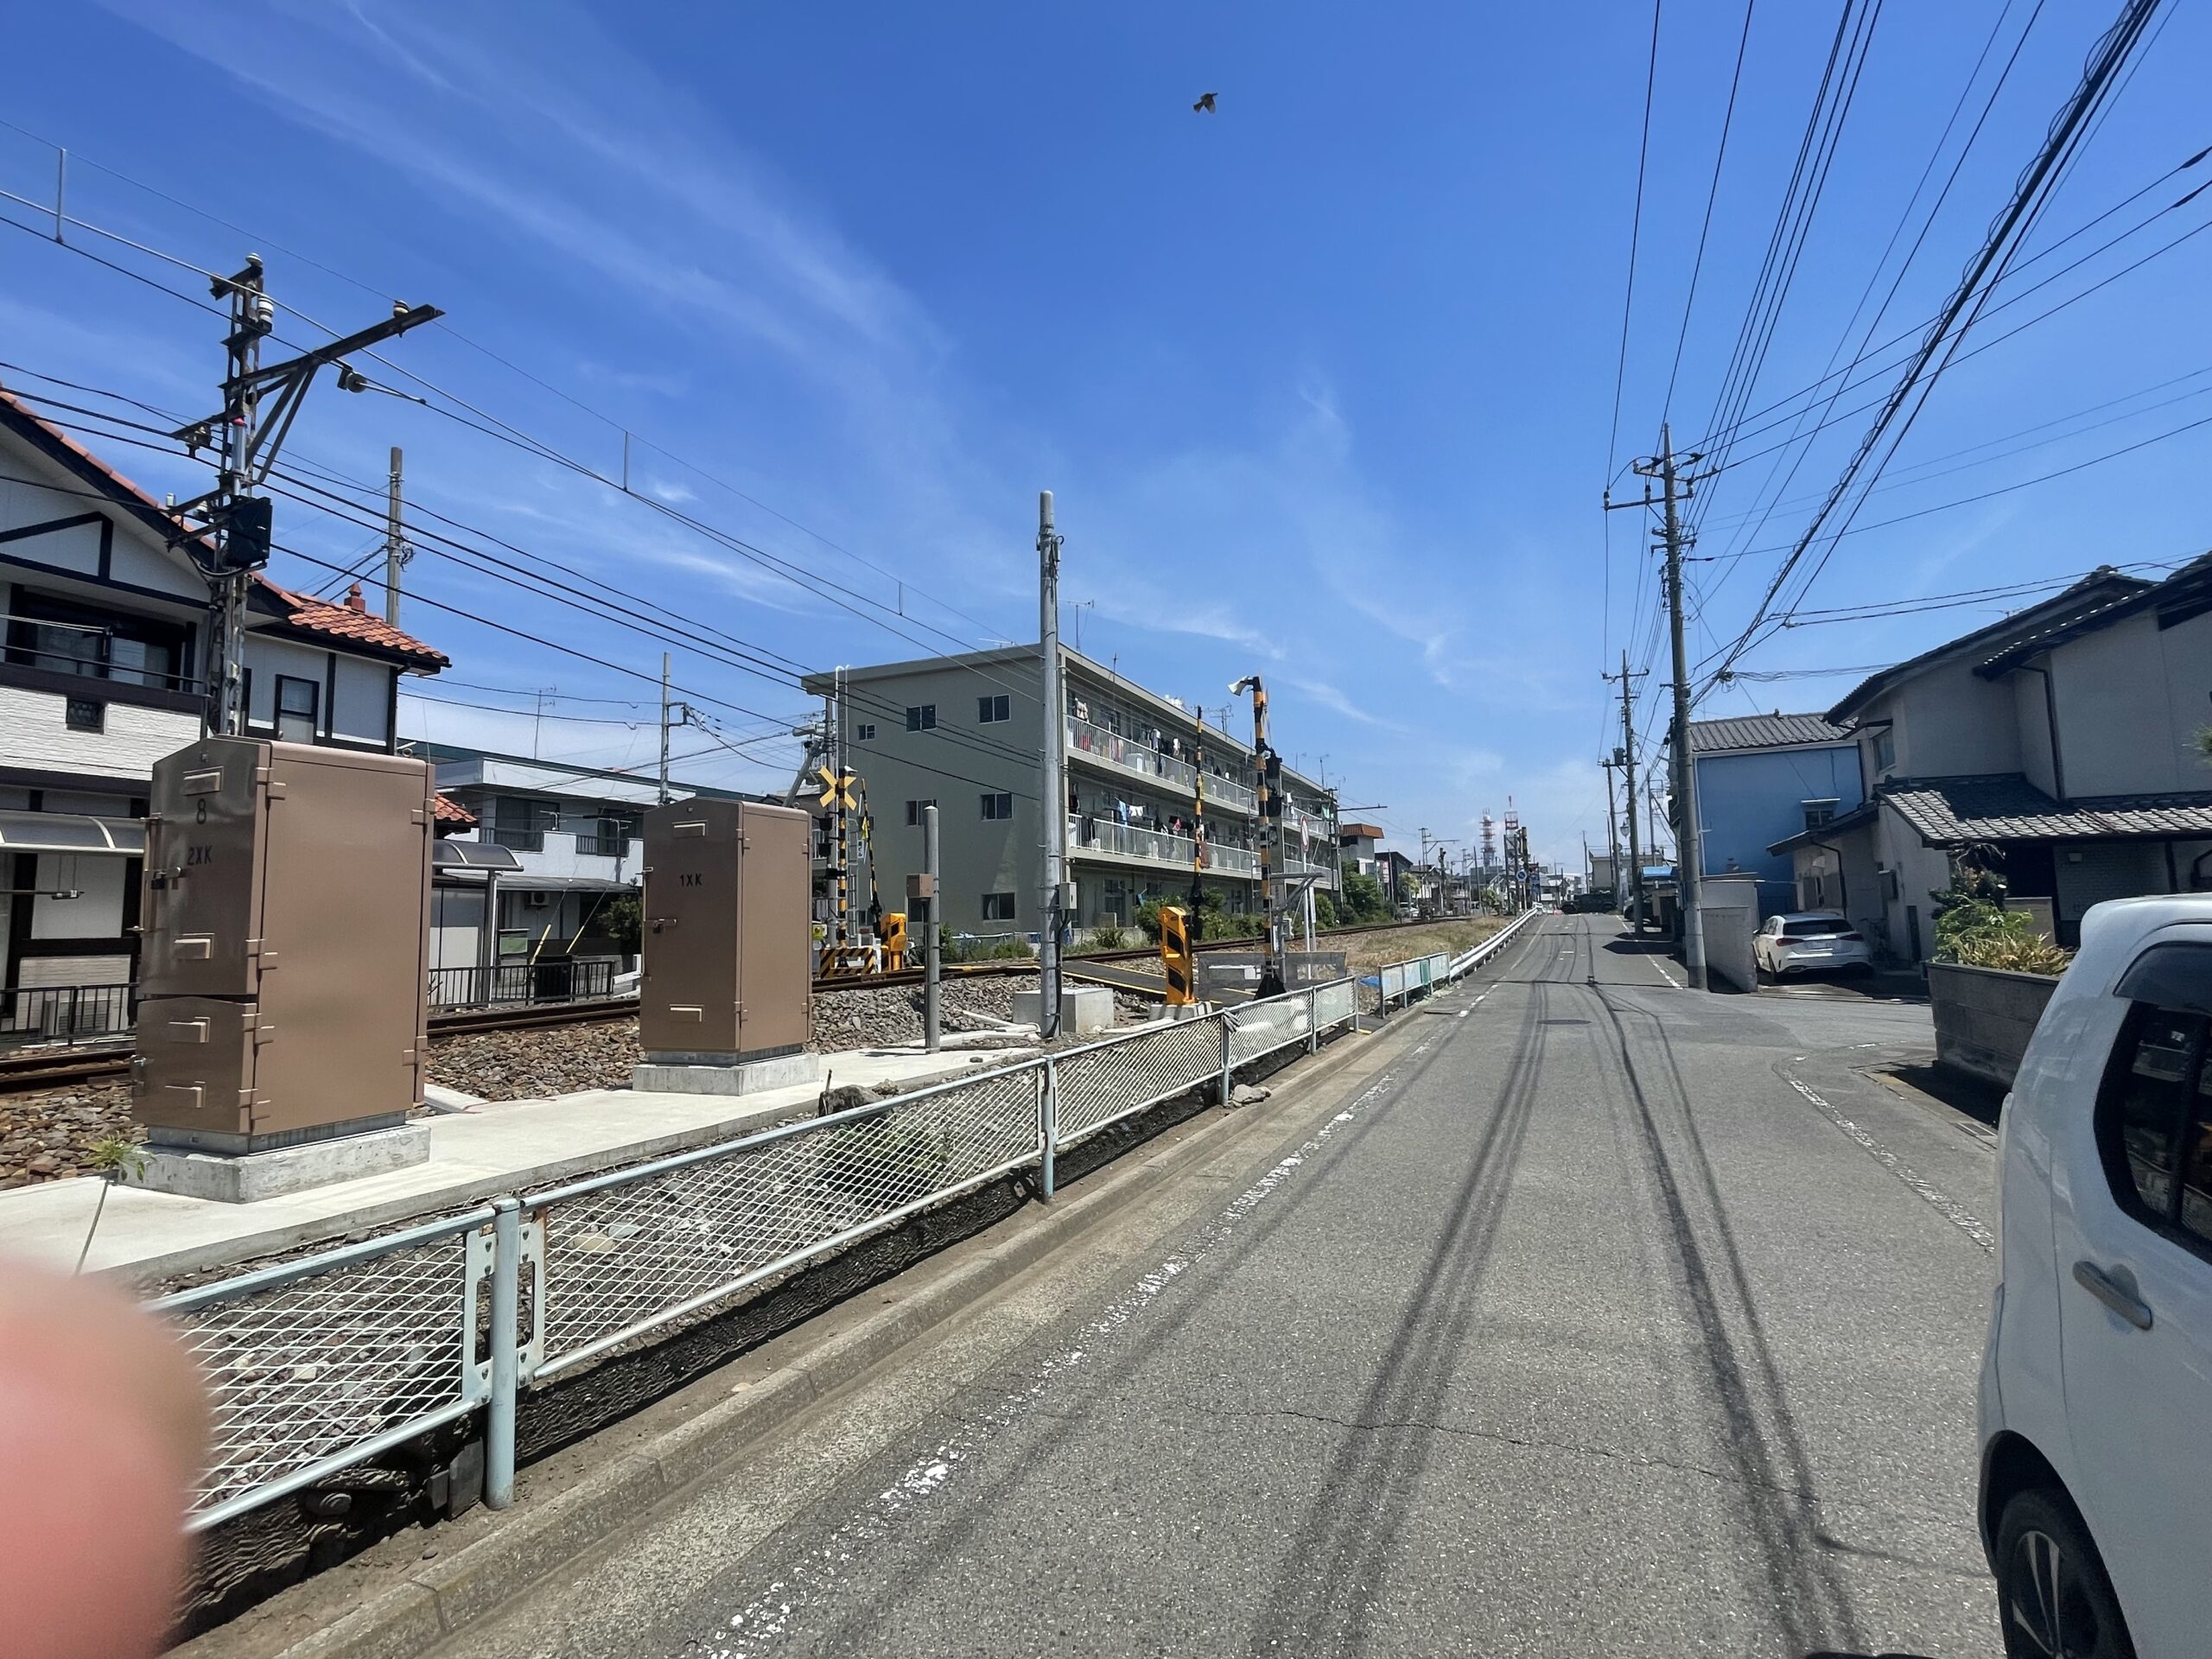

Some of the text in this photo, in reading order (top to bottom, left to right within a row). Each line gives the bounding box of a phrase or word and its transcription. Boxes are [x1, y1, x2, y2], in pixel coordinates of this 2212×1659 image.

[196, 798, 207, 824] 8
[187, 845, 213, 866] 2XK
[679, 873, 702, 887] 1XK
